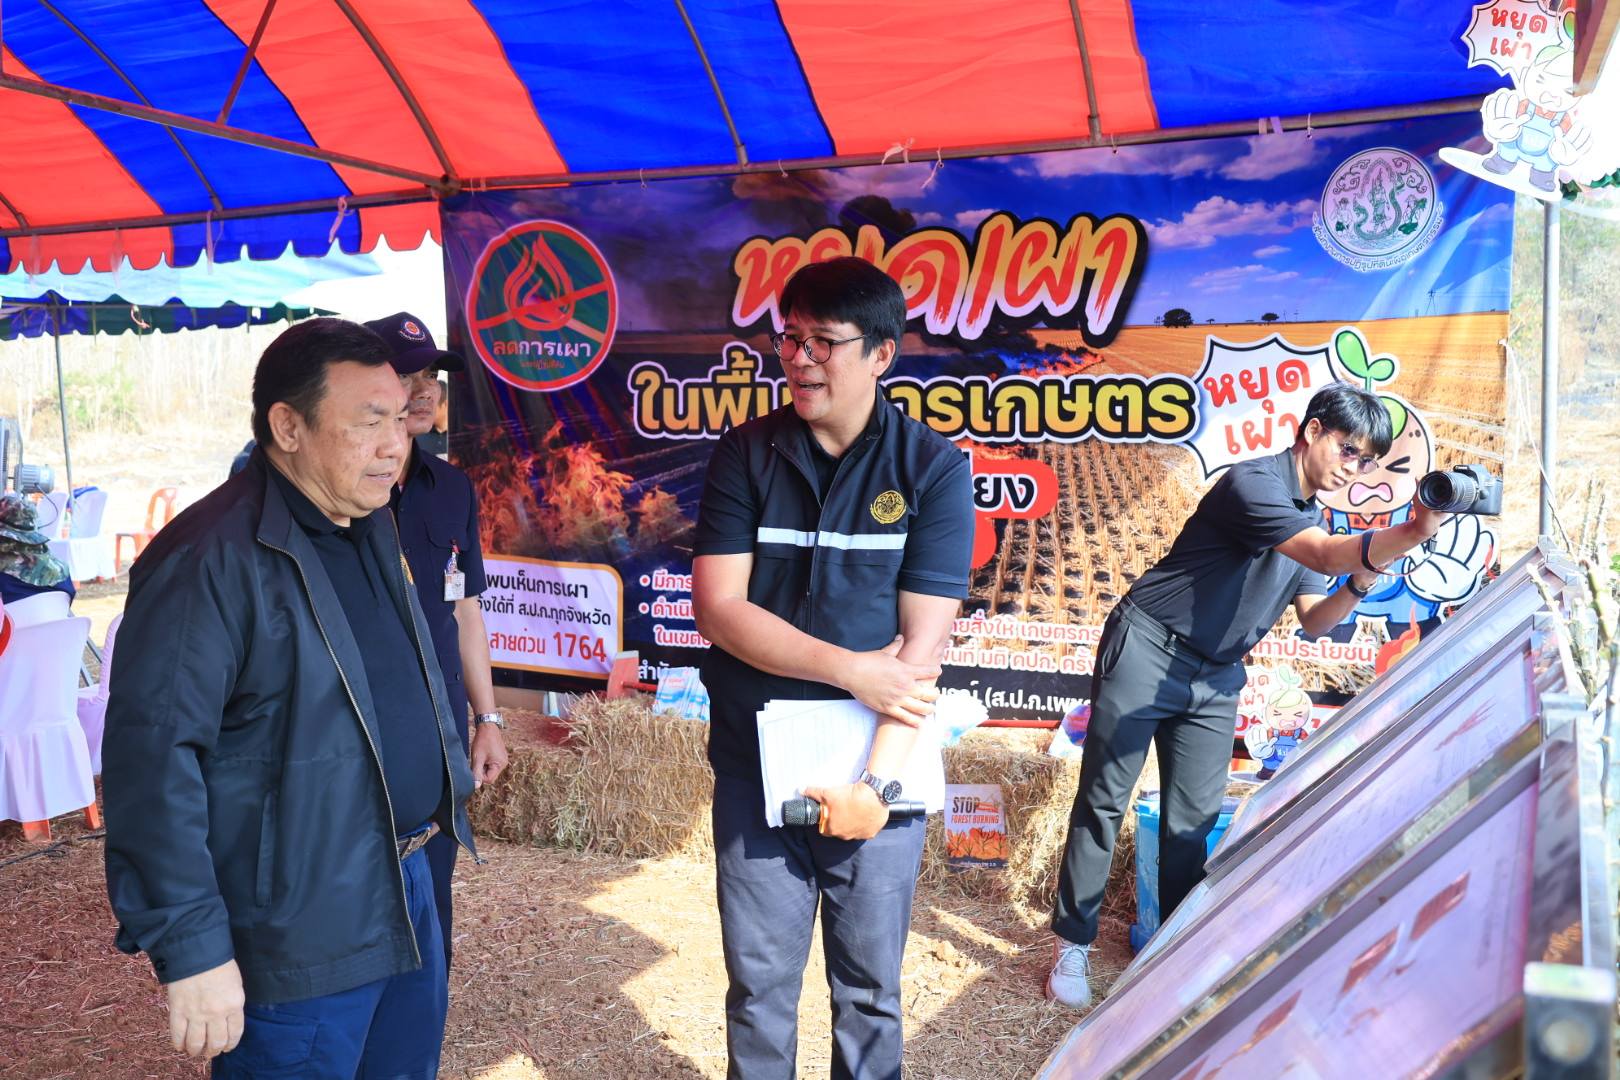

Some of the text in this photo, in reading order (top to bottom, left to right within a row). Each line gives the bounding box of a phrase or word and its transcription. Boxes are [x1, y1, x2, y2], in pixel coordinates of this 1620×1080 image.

[1491, 8, 1547, 39] หยุด
[1490, 37, 1532, 59] เผา
[493, 341, 591, 357] ลดการเผา
[1203, 358, 1311, 414] หยุด
[489, 628, 607, 662] สายด่วน 1764
[952, 796, 980, 813] STOP
[951, 815, 972, 823] FOREST
